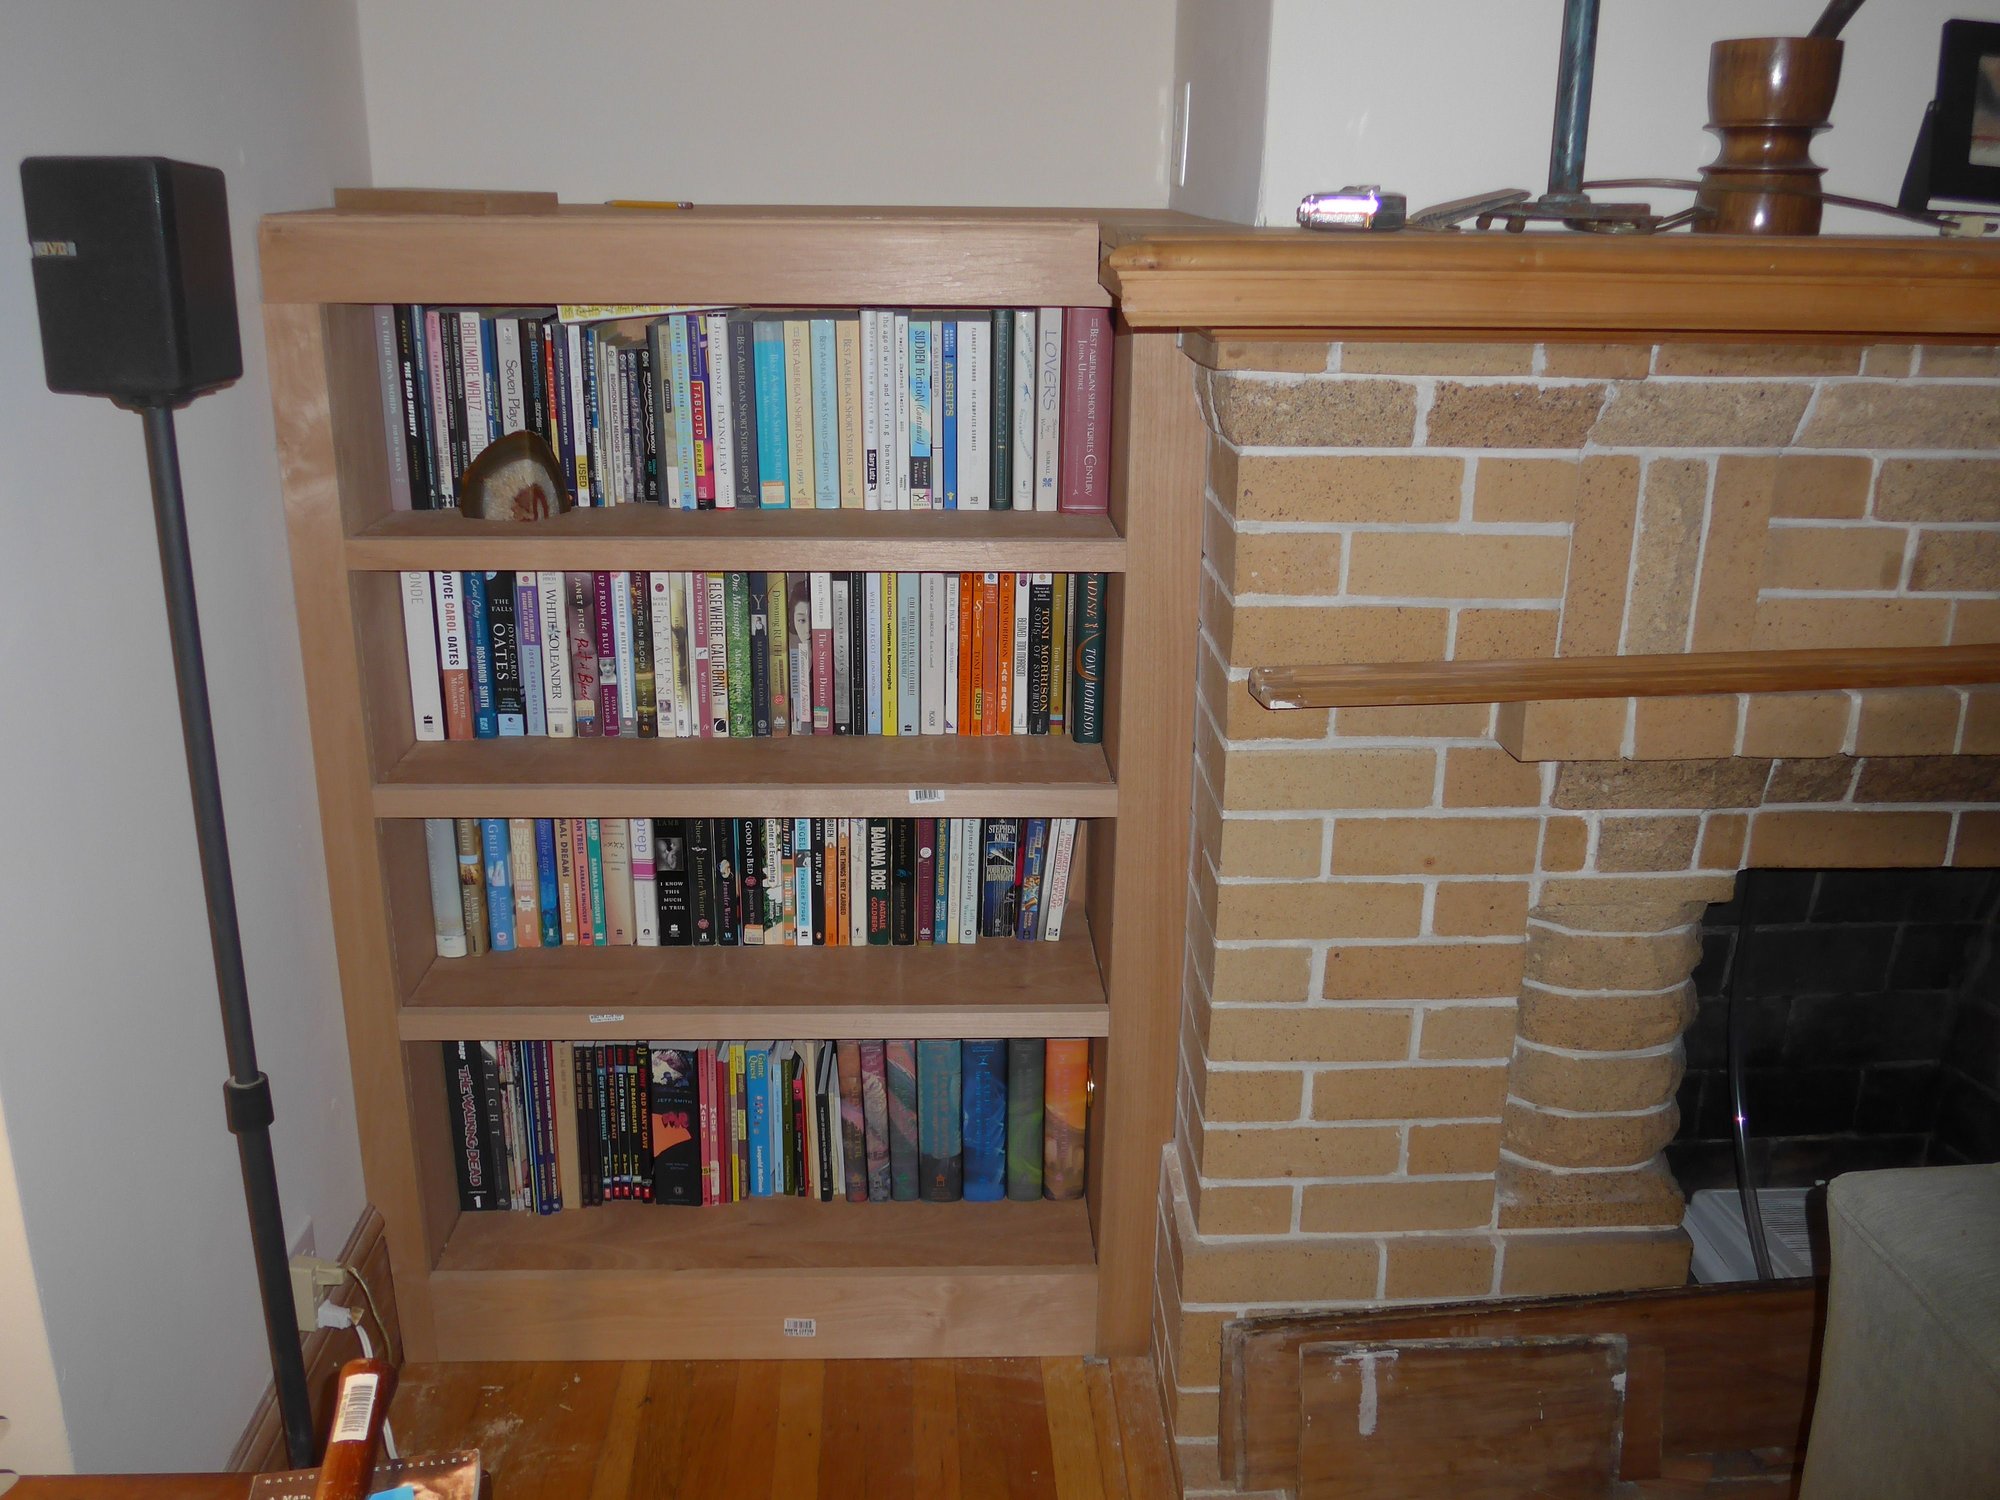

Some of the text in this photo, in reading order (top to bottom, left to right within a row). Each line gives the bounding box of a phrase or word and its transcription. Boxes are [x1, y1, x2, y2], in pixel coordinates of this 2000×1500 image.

[737, 336, 746, 357] BEST
[462, 322, 481, 411] BALTIMORE WALTZ
[737, 357, 748, 401] AMERICAN
[1042, 329, 1057, 410] LOVERS
[1077, 340, 1087, 391] JOHN UPDIKE
[505, 360, 520, 427] Seven Plays
[945, 362, 953, 416] AIRSHIPS
[1087, 328, 1099, 453] BEST AMERICAN SHORT STORIES
[407, 400, 417, 438] INFINITY
[693, 386, 704, 473] TABLOID DREAMS
[717, 405, 726, 445] FLYING
[740, 403, 748, 430] SHORT
[741, 431, 749, 463] STORIES
[868, 453, 876, 466] Gary
[578, 463, 587, 488] USED
[1084, 454, 1097, 496] CENTURY
[409, 572, 424, 605] ONDE
[598, 575, 605, 587] UP
[446, 603, 457, 633] CAROL
[574, 577, 585, 634] JANET FITCH
[601, 618, 609, 629] the
[636, 590, 644, 626] WINTERS
[732, 574, 742, 639] One Mississippi
[772, 590, 782, 656] Drowning RUTH
[447, 636, 459, 665] OATES
[545, 589, 562, 699] WHITE OLEANDER
[639, 629, 645, 637] IN
[709, 583, 725, 696] ELSEWHERE, CALIFORNIA
[493, 623, 509, 680] OATES
[507, 623, 518, 681] JOYCE CAROL
[638, 641, 646, 669] BLOOM
[654, 615, 664, 695] HEAVEN
[1040, 608, 1049, 712] TONI MORRISON
[603, 688, 611, 723] HENDERSON
[820, 678, 828, 706] Diaries
[1083, 648, 1096, 737] TONI MORRISON
[488, 824, 498, 858] GRIEF
[989, 824, 1015, 833] STEPHEN
[746, 847, 752, 856] IN
[746, 858, 754, 874] BED
[871, 827, 886, 890] BANANA ROSE
[1055, 850, 1063, 875] WHISTLE
[561, 842, 571, 923] DREAMS KINGSOLVER
[696, 856, 705, 888] Jennifer
[463, 888, 471, 931] MORIARTY
[698, 890, 706, 917] Weiner
[1057, 876, 1066, 907] TOMATOES
[471, 897, 479, 923] LAURA
[750, 1055, 758, 1079] Quest
[484, 1060, 499, 1136] FLIGHT
[620, 1089, 624, 1097] OF
[459, 1065, 481, 1186] THE WALKING DEAD
[265, 1456, 469, 1484] NATIO ESTSELLER
